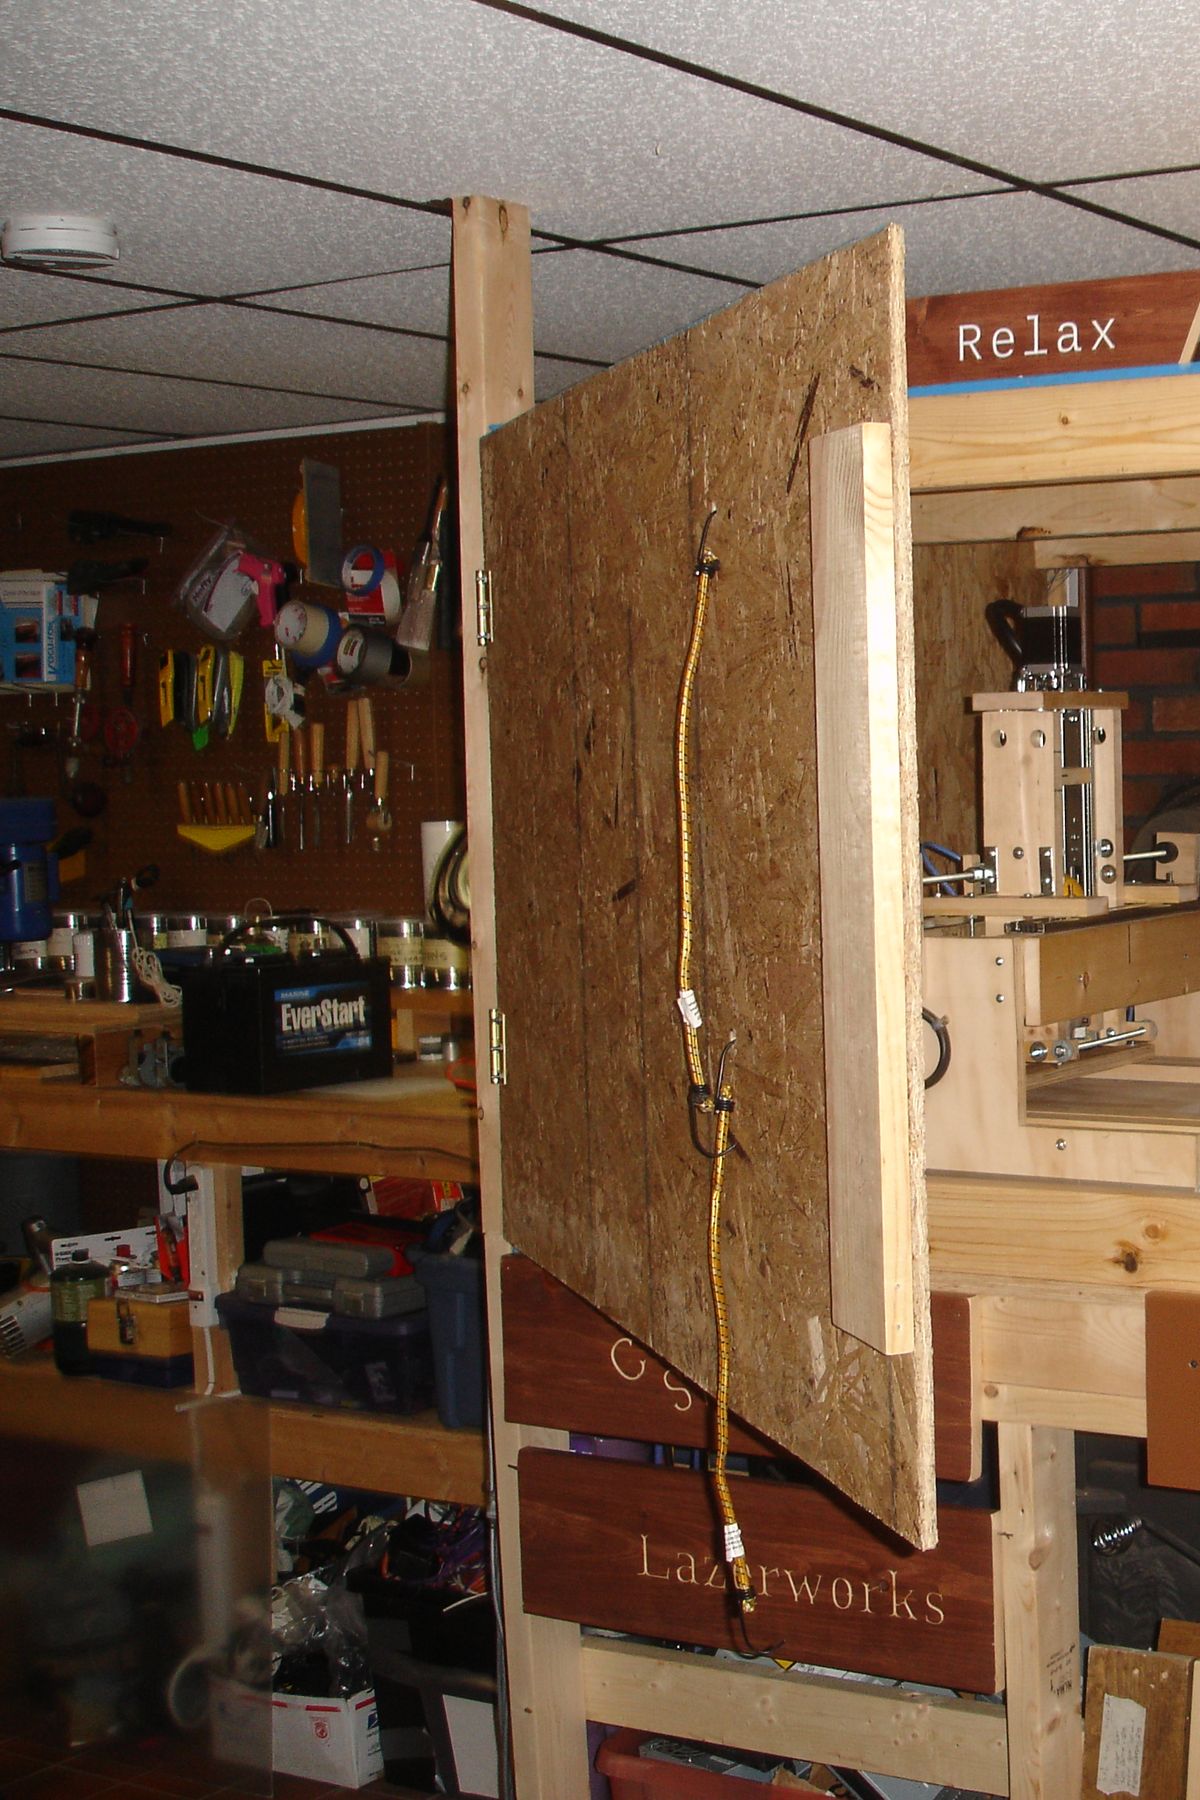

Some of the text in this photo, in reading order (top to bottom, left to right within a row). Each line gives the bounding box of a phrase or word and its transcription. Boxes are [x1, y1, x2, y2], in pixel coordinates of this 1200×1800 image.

[956, 313, 1117, 363] Relax
[281, 995, 366, 1032] EverStart
[636, 1532, 946, 1626] Lazerworks
